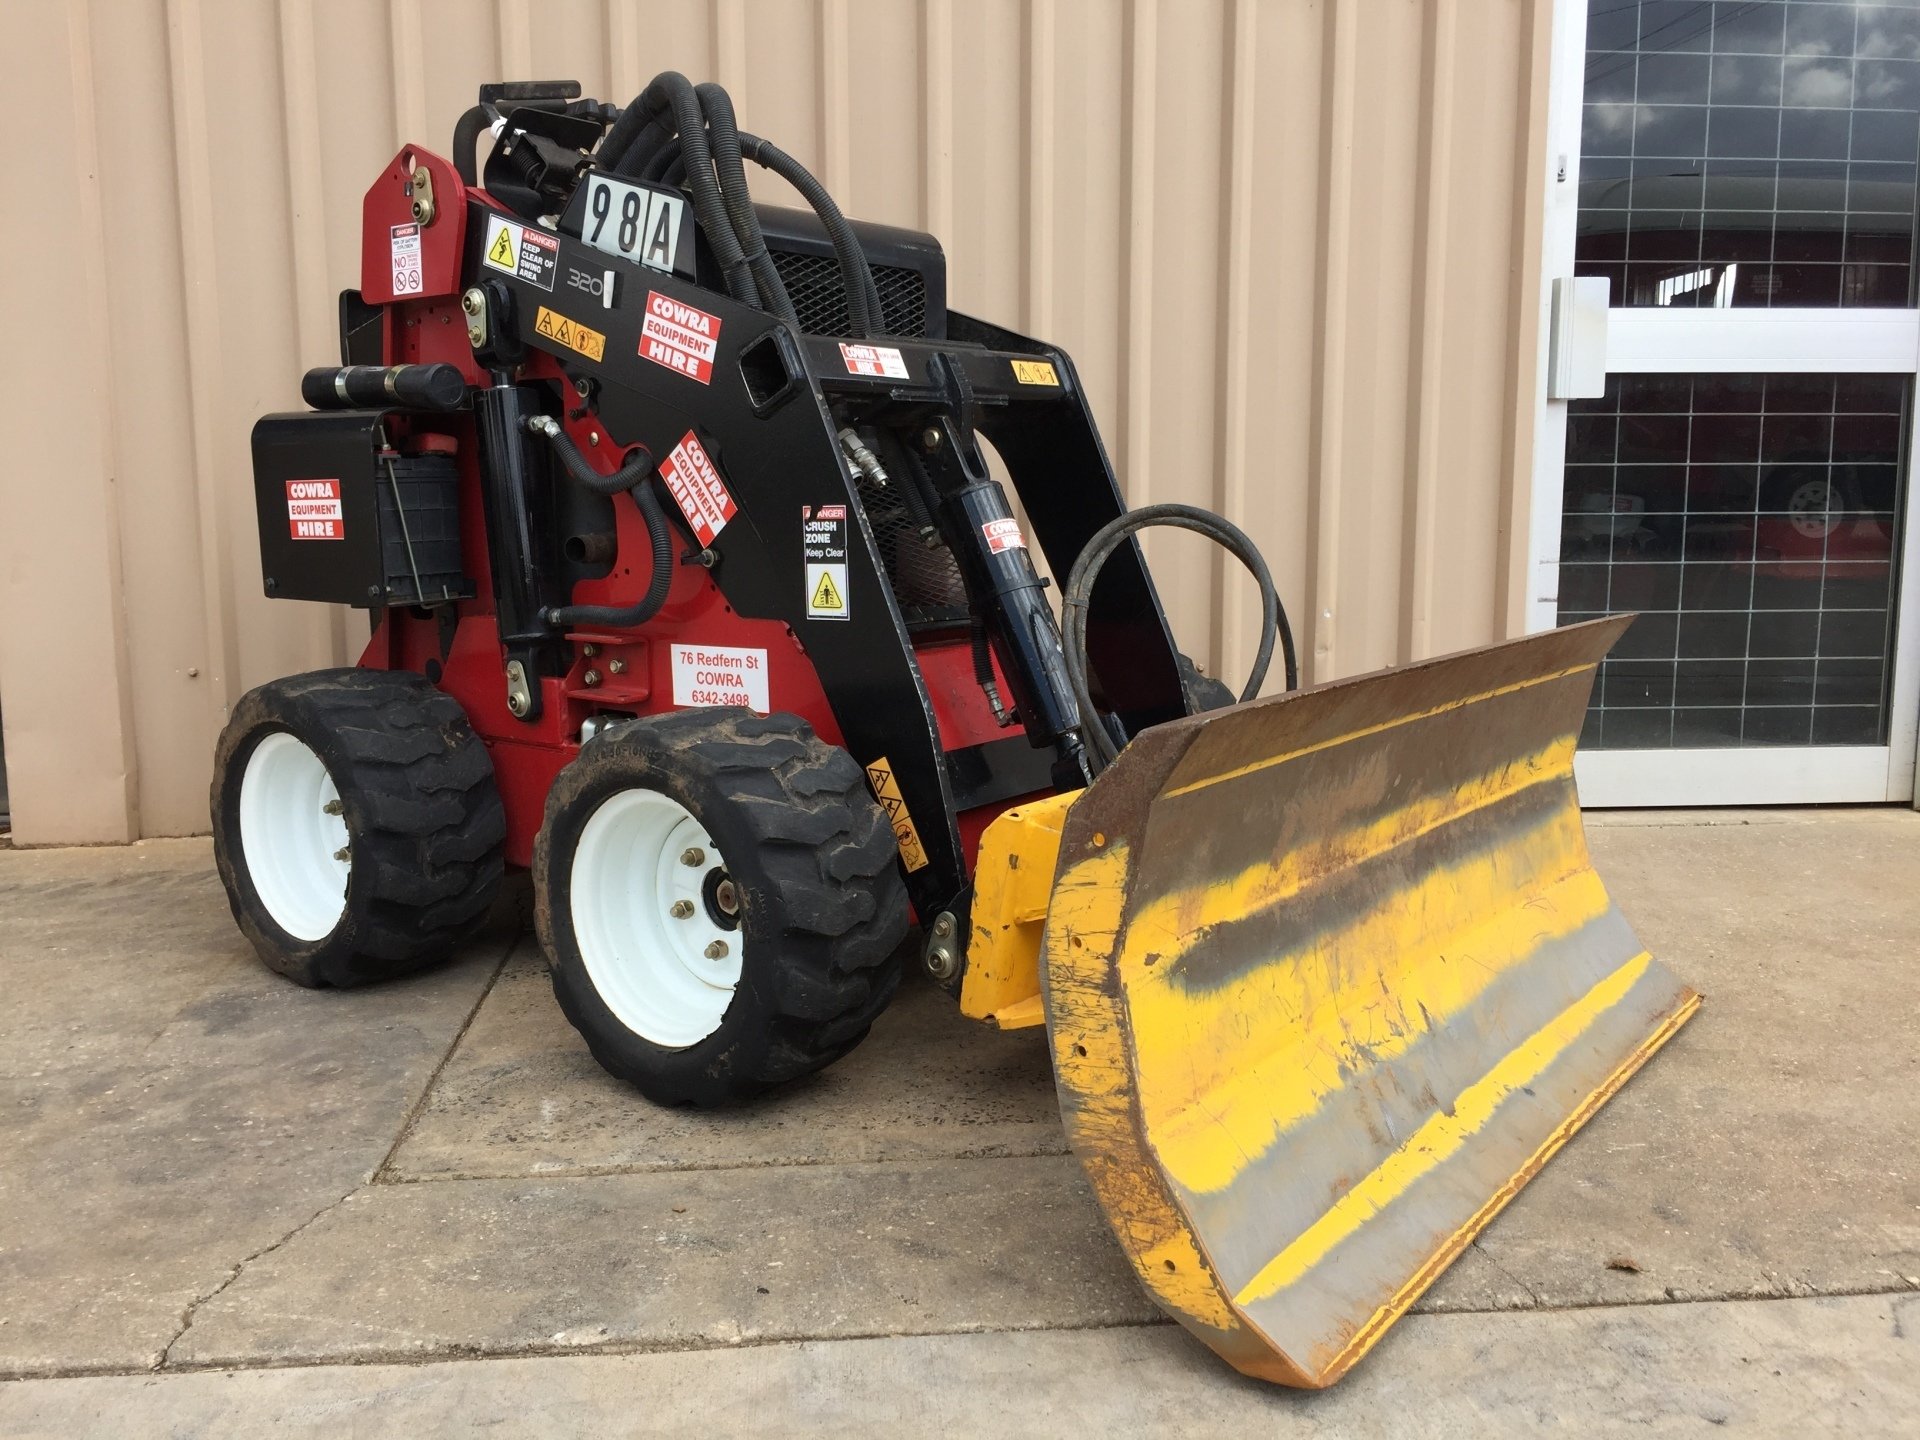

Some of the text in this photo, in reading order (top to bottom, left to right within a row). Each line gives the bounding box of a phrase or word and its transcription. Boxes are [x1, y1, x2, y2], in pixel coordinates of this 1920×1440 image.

[522, 242, 541, 254] KEEP
[530, 233, 557, 249] DANGER
[394, 256, 407, 269] NO
[520, 260, 542, 274] SWING
[521, 252, 555, 269] CLEAR OF
[519, 268, 538, 282] AREA
[567, 268, 604, 296] 320
[653, 297, 710, 335] COWRA
[647, 320, 710, 354] EQUIPMENT
[648, 340, 700, 376] HIRE
[687, 440, 729, 512] COWRA
[290, 482, 334, 499] COWRA
[675, 451, 719, 523] EQUIPMENT
[667, 469, 705, 532] HIRE
[291, 504, 336, 516] EQUIPMENT
[817, 509, 843, 518] ANGER
[297, 521, 335, 537] HIRE
[805, 521, 837, 532] CRUSH
[805, 534, 831, 544] ZONE
[806, 548, 844, 559] Keep Clear
[680, 652, 759, 669] 76 Redfern St
[696, 671, 744, 688] COWRA
[692, 690, 749, 707] 6342-3498
